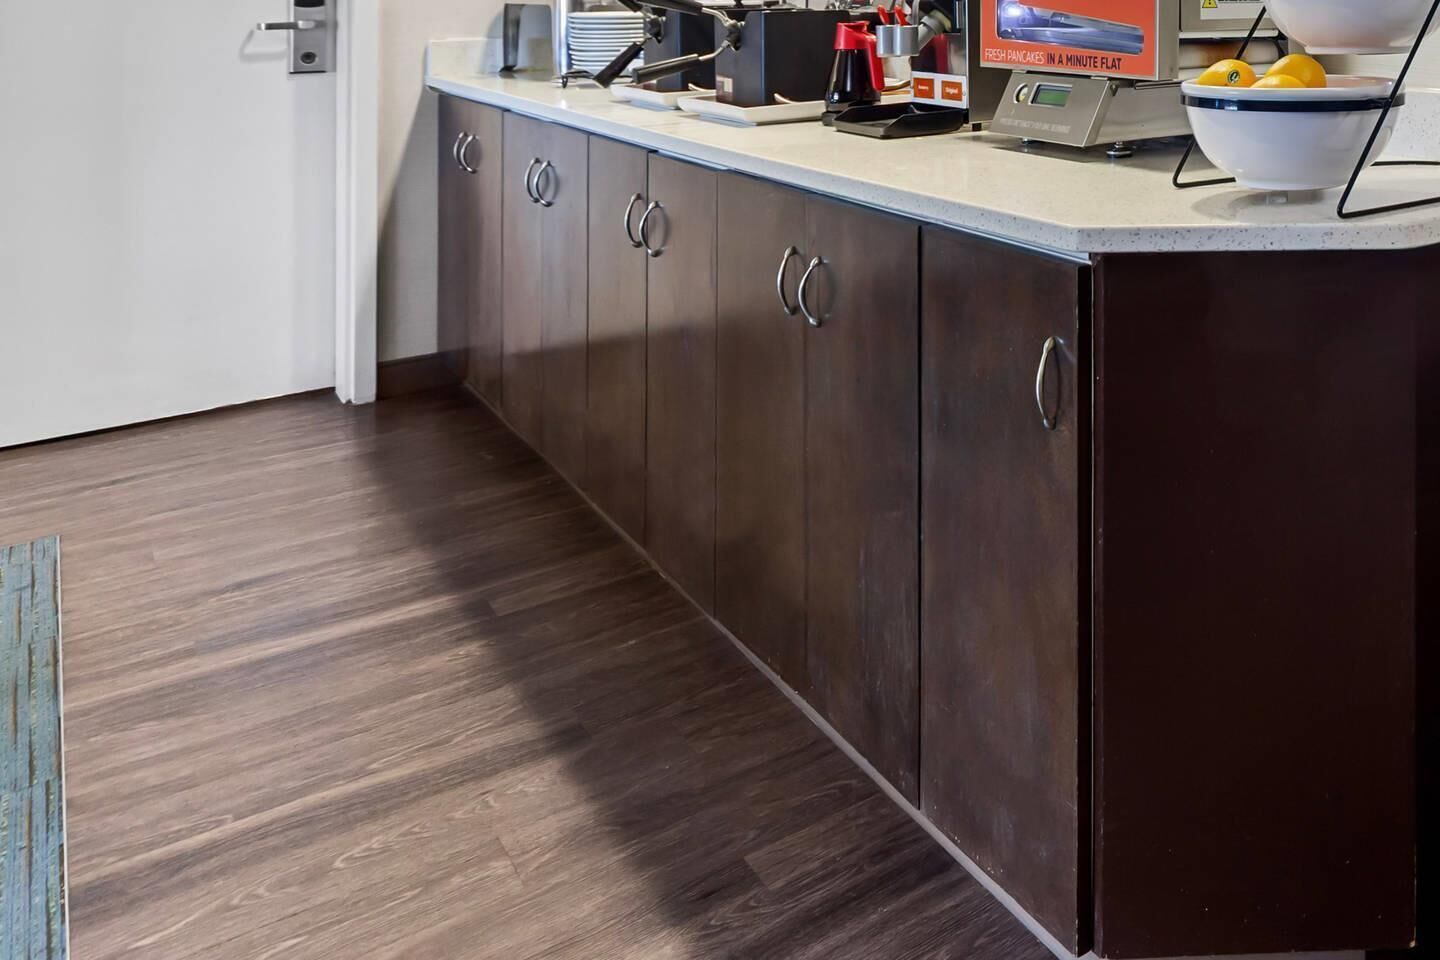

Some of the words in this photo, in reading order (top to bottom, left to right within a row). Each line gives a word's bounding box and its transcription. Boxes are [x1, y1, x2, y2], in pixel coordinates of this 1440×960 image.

[985, 48, 1006, 61] FRESH
[1007, 49, 1045, 64] PANCAKES
[1047, 52, 1056, 65] IN
[1057, 53, 1064, 66] A
[1065, 54, 1099, 69] MINUTE
[1100, 56, 1122, 71] FLAT
